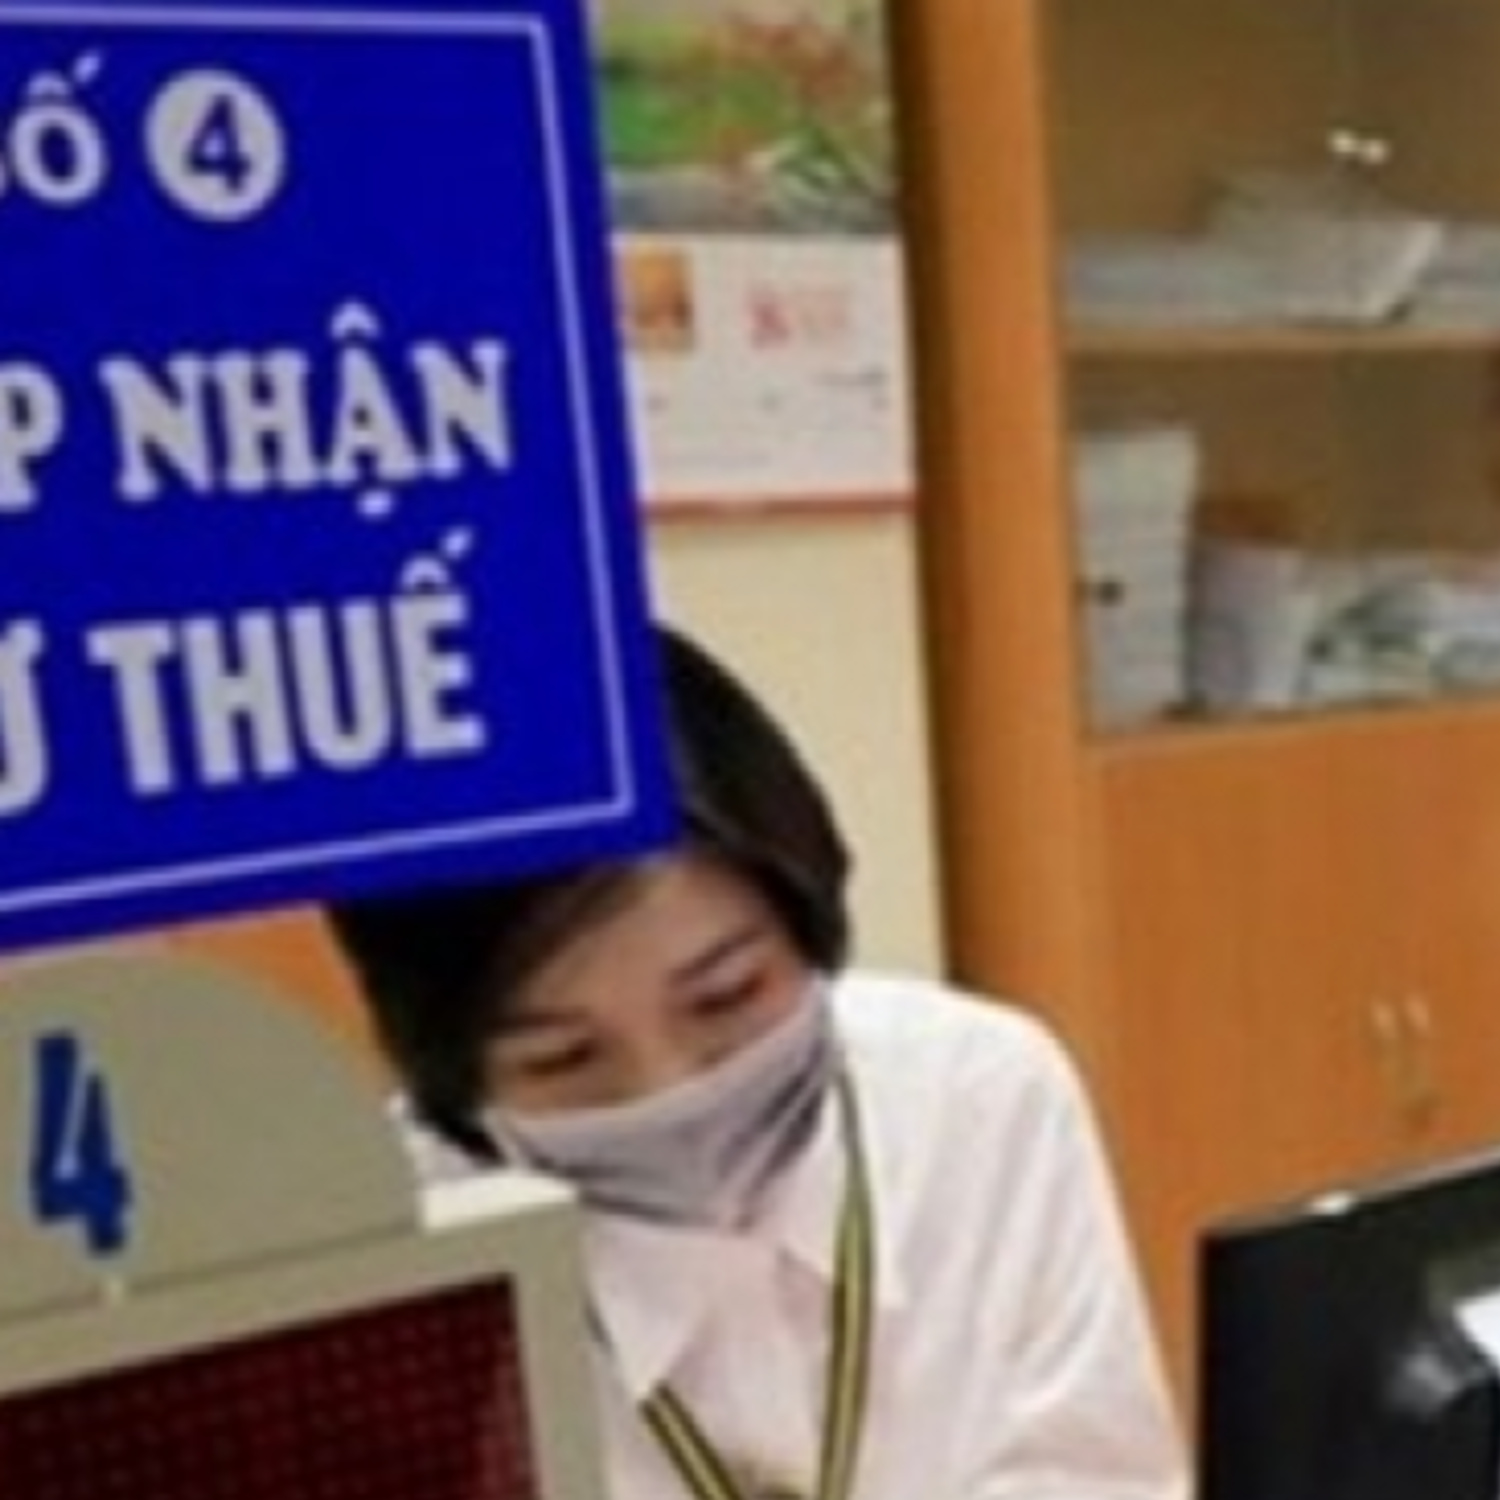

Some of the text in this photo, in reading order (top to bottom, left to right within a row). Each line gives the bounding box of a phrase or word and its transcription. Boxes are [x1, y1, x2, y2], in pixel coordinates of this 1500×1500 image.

[0, 51, 105, 204] Ố
[97, 300, 512, 518] NHẬN
[85, 527, 487, 796] THUẾ
[30, 1030, 134, 1256] 4
